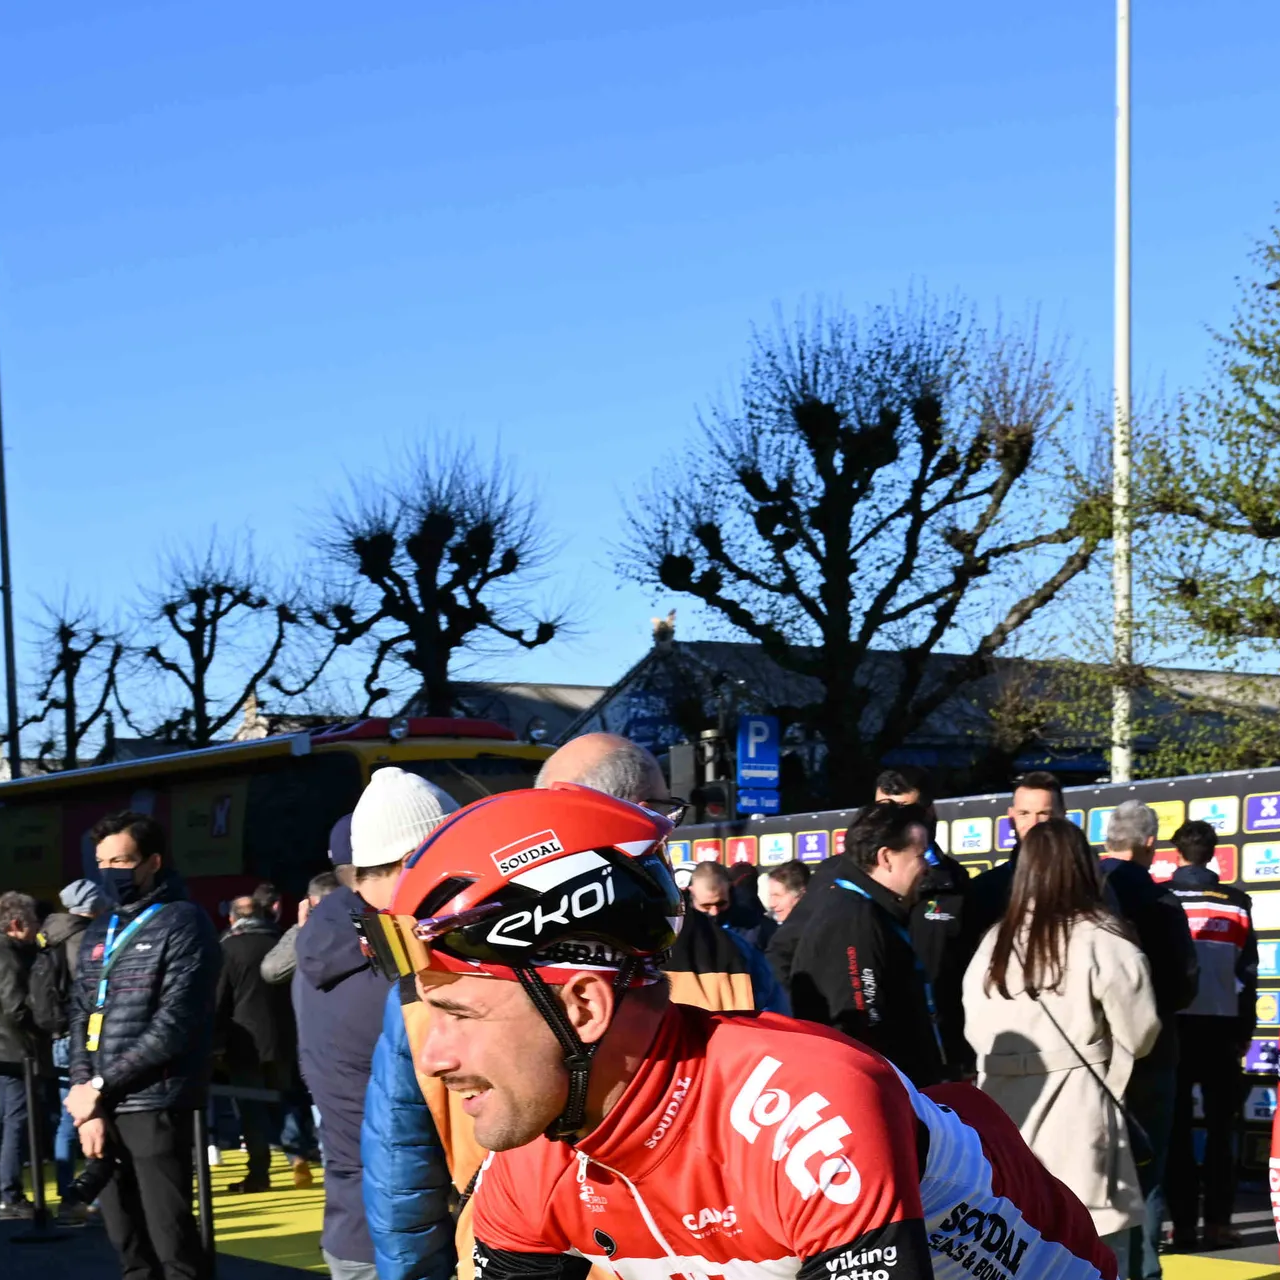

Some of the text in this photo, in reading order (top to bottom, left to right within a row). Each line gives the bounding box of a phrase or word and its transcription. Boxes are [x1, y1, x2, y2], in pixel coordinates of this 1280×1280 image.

[747, 720, 769, 758] P
[498, 841, 561, 875] SOUDAL
[1255, 865, 1280, 876] KBC
[643, 1075, 692, 1150] SOUDAL
[729, 1055, 862, 1205] lotto
[825, 1245, 898, 1272] viking
[961, 1250, 976, 1272] &
